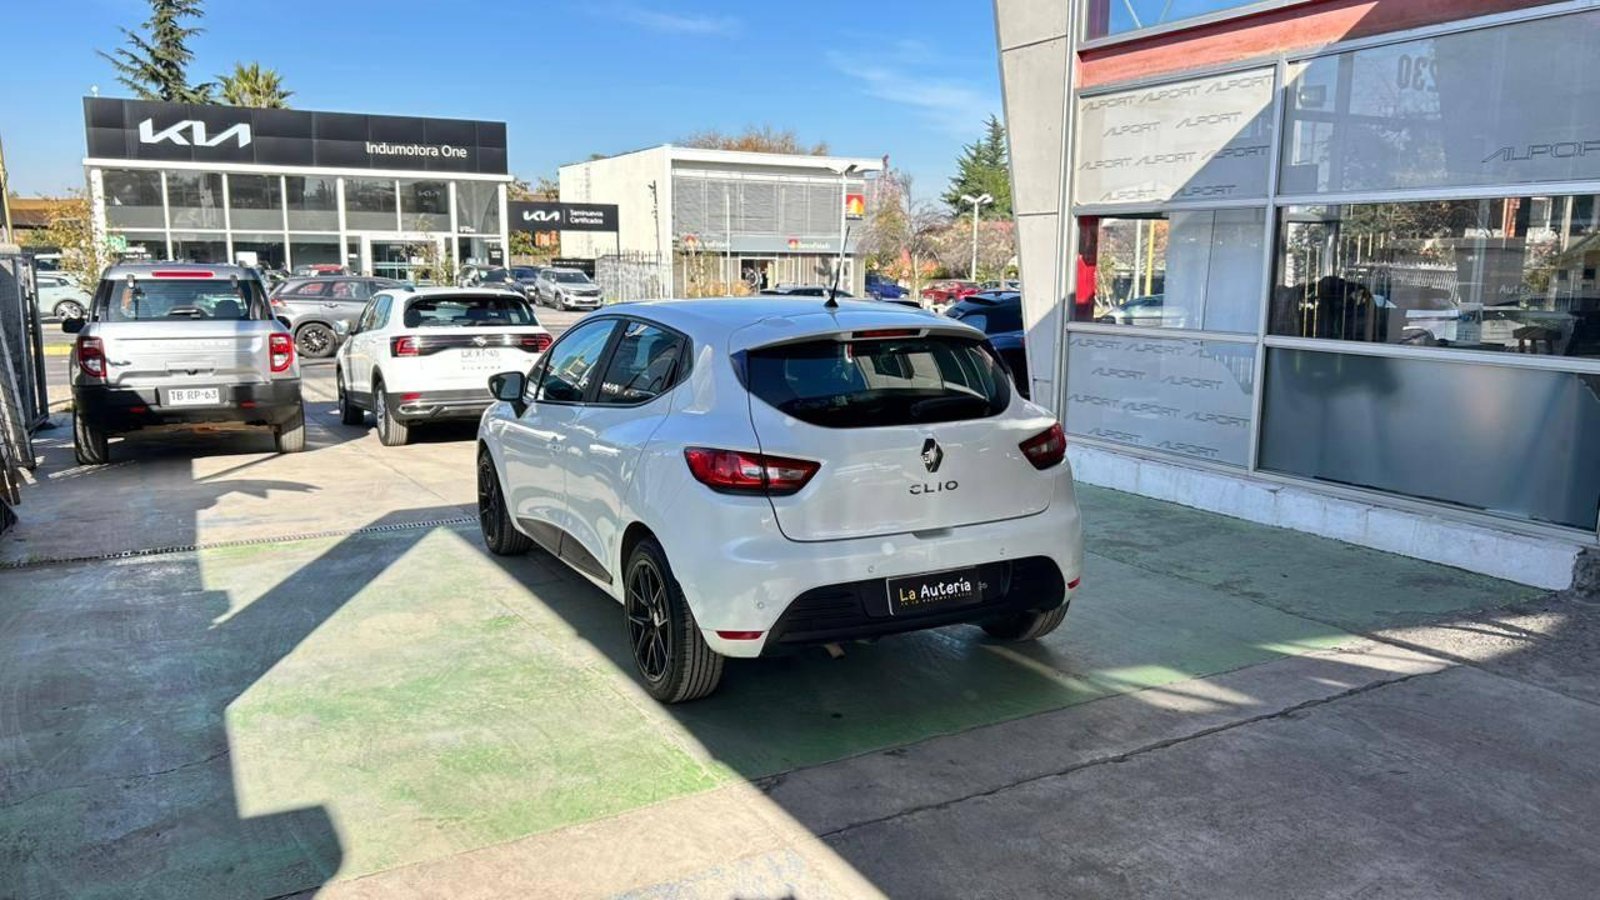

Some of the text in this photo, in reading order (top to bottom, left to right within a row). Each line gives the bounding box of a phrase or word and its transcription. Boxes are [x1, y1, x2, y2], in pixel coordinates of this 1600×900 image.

[139, 118, 251, 148] KIA
[365, 141, 467, 158] Indumotora One
[522, 210, 560, 221] KIA
[909, 480, 959, 495] CLIO
[899, 588, 916, 601] La
[920, 577, 971, 599] Autería
